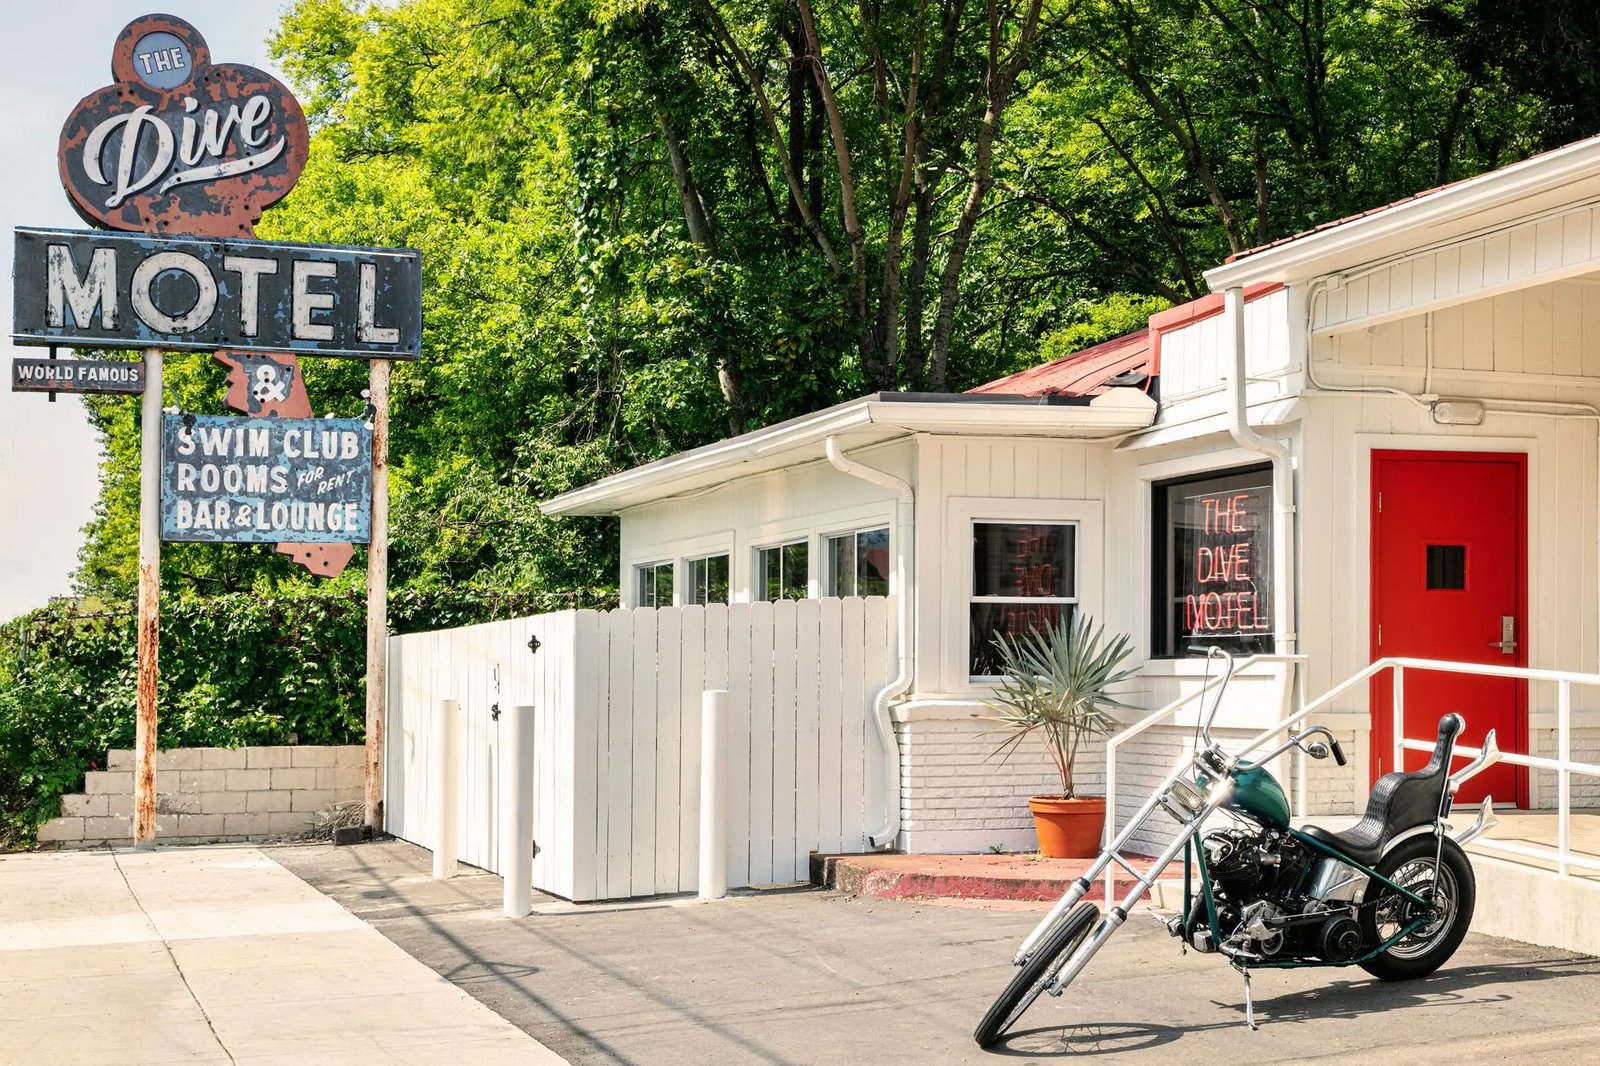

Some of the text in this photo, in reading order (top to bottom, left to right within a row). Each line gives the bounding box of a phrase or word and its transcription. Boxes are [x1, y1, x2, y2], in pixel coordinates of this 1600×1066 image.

[138, 47, 186, 75] THE
[83, 95, 285, 208] Dive
[46, 243, 400, 344] MOTEL
[18, 365, 139, 382] WORLD FAMOUS
[253, 364, 286, 402] &
[177, 427, 359, 459] SWIM CLUB
[177, 463, 289, 493] ROOMS
[297, 467, 324, 490] FOR
[317, 470, 354, 495] RENT
[1202, 495, 1249, 535] THE
[1197, 543, 1251, 583] DIVE
[1185, 591, 1269, 630] MOTEL
